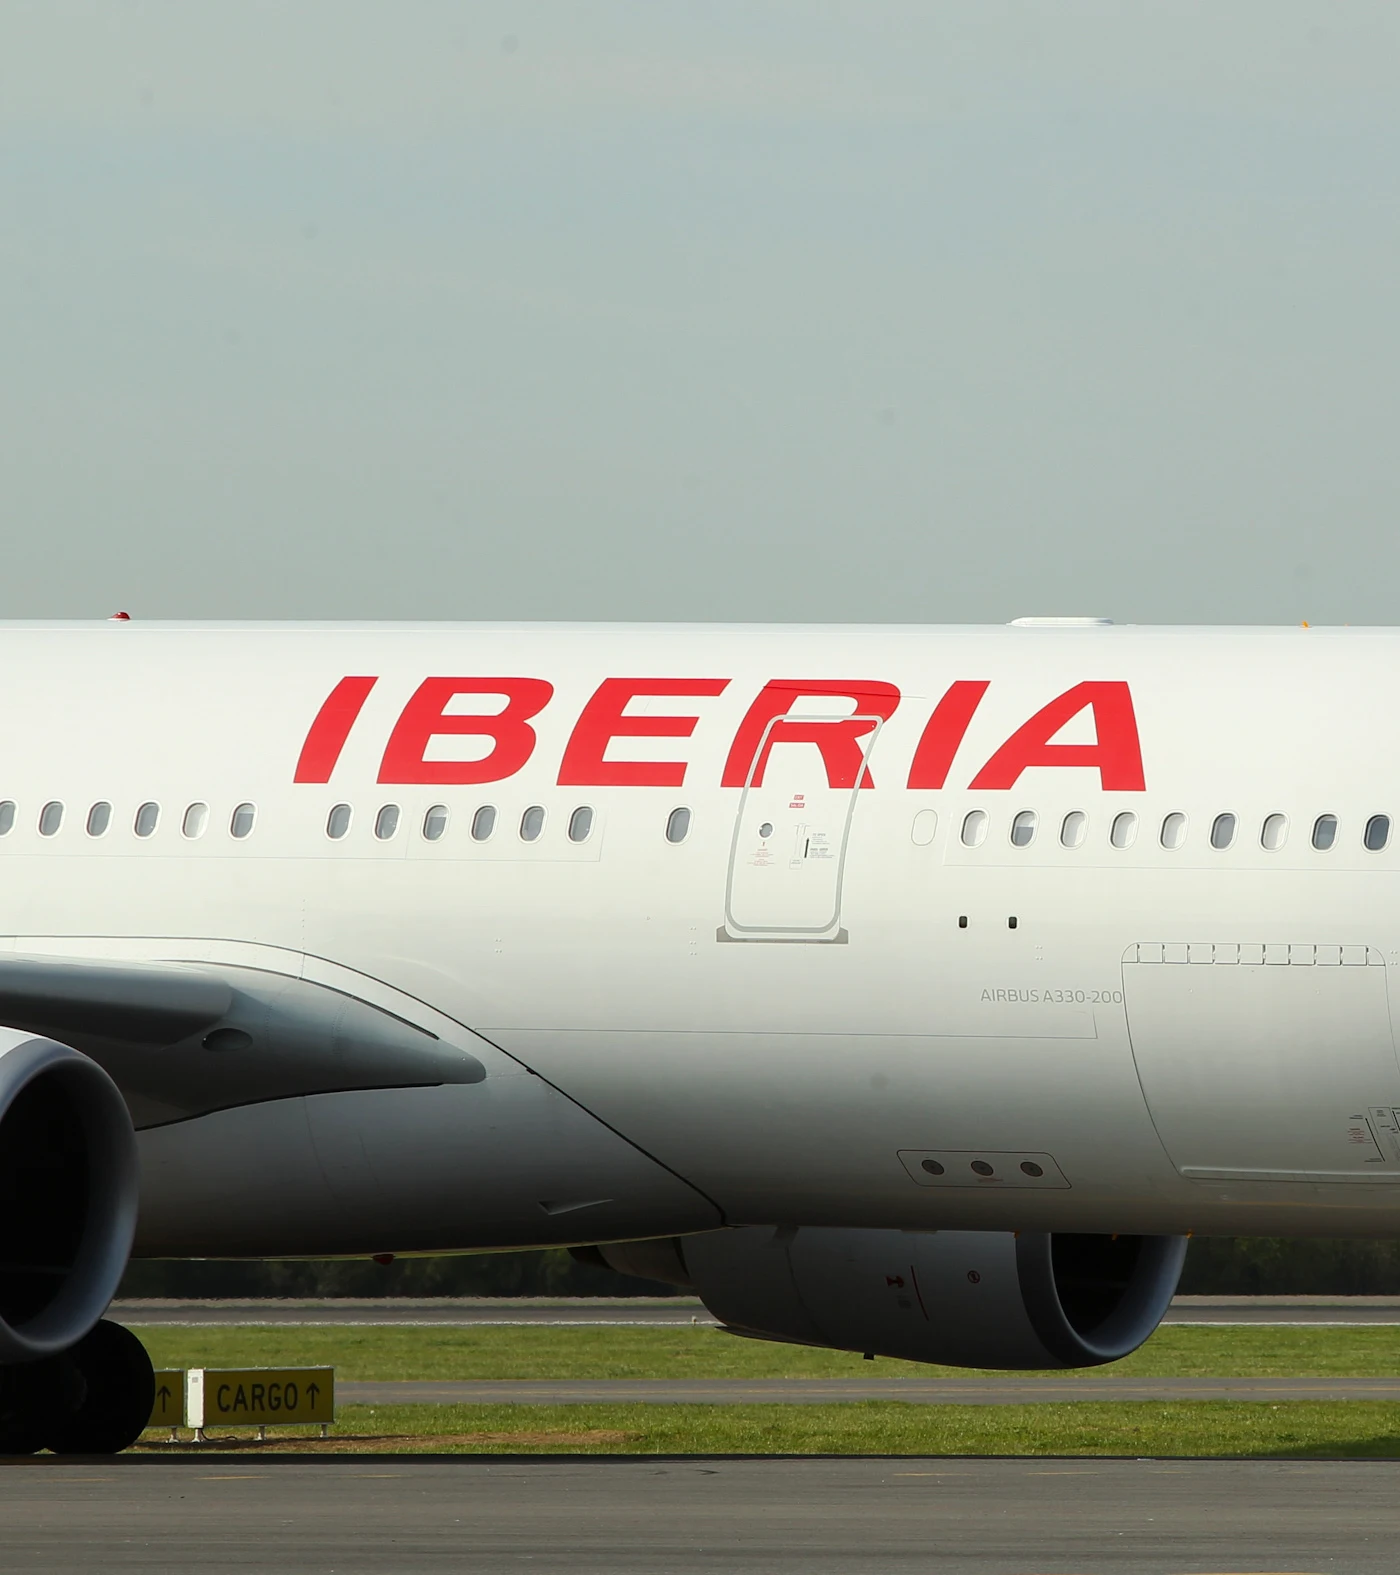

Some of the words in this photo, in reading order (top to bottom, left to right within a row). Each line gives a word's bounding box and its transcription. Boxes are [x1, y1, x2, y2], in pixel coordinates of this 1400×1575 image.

[293, 676, 1146, 791] IBERIA
[980, 988, 1039, 1003] AIRBUS
[1042, 989, 1123, 1004] A330-200
[217, 1382, 298, 1413] CARGO
